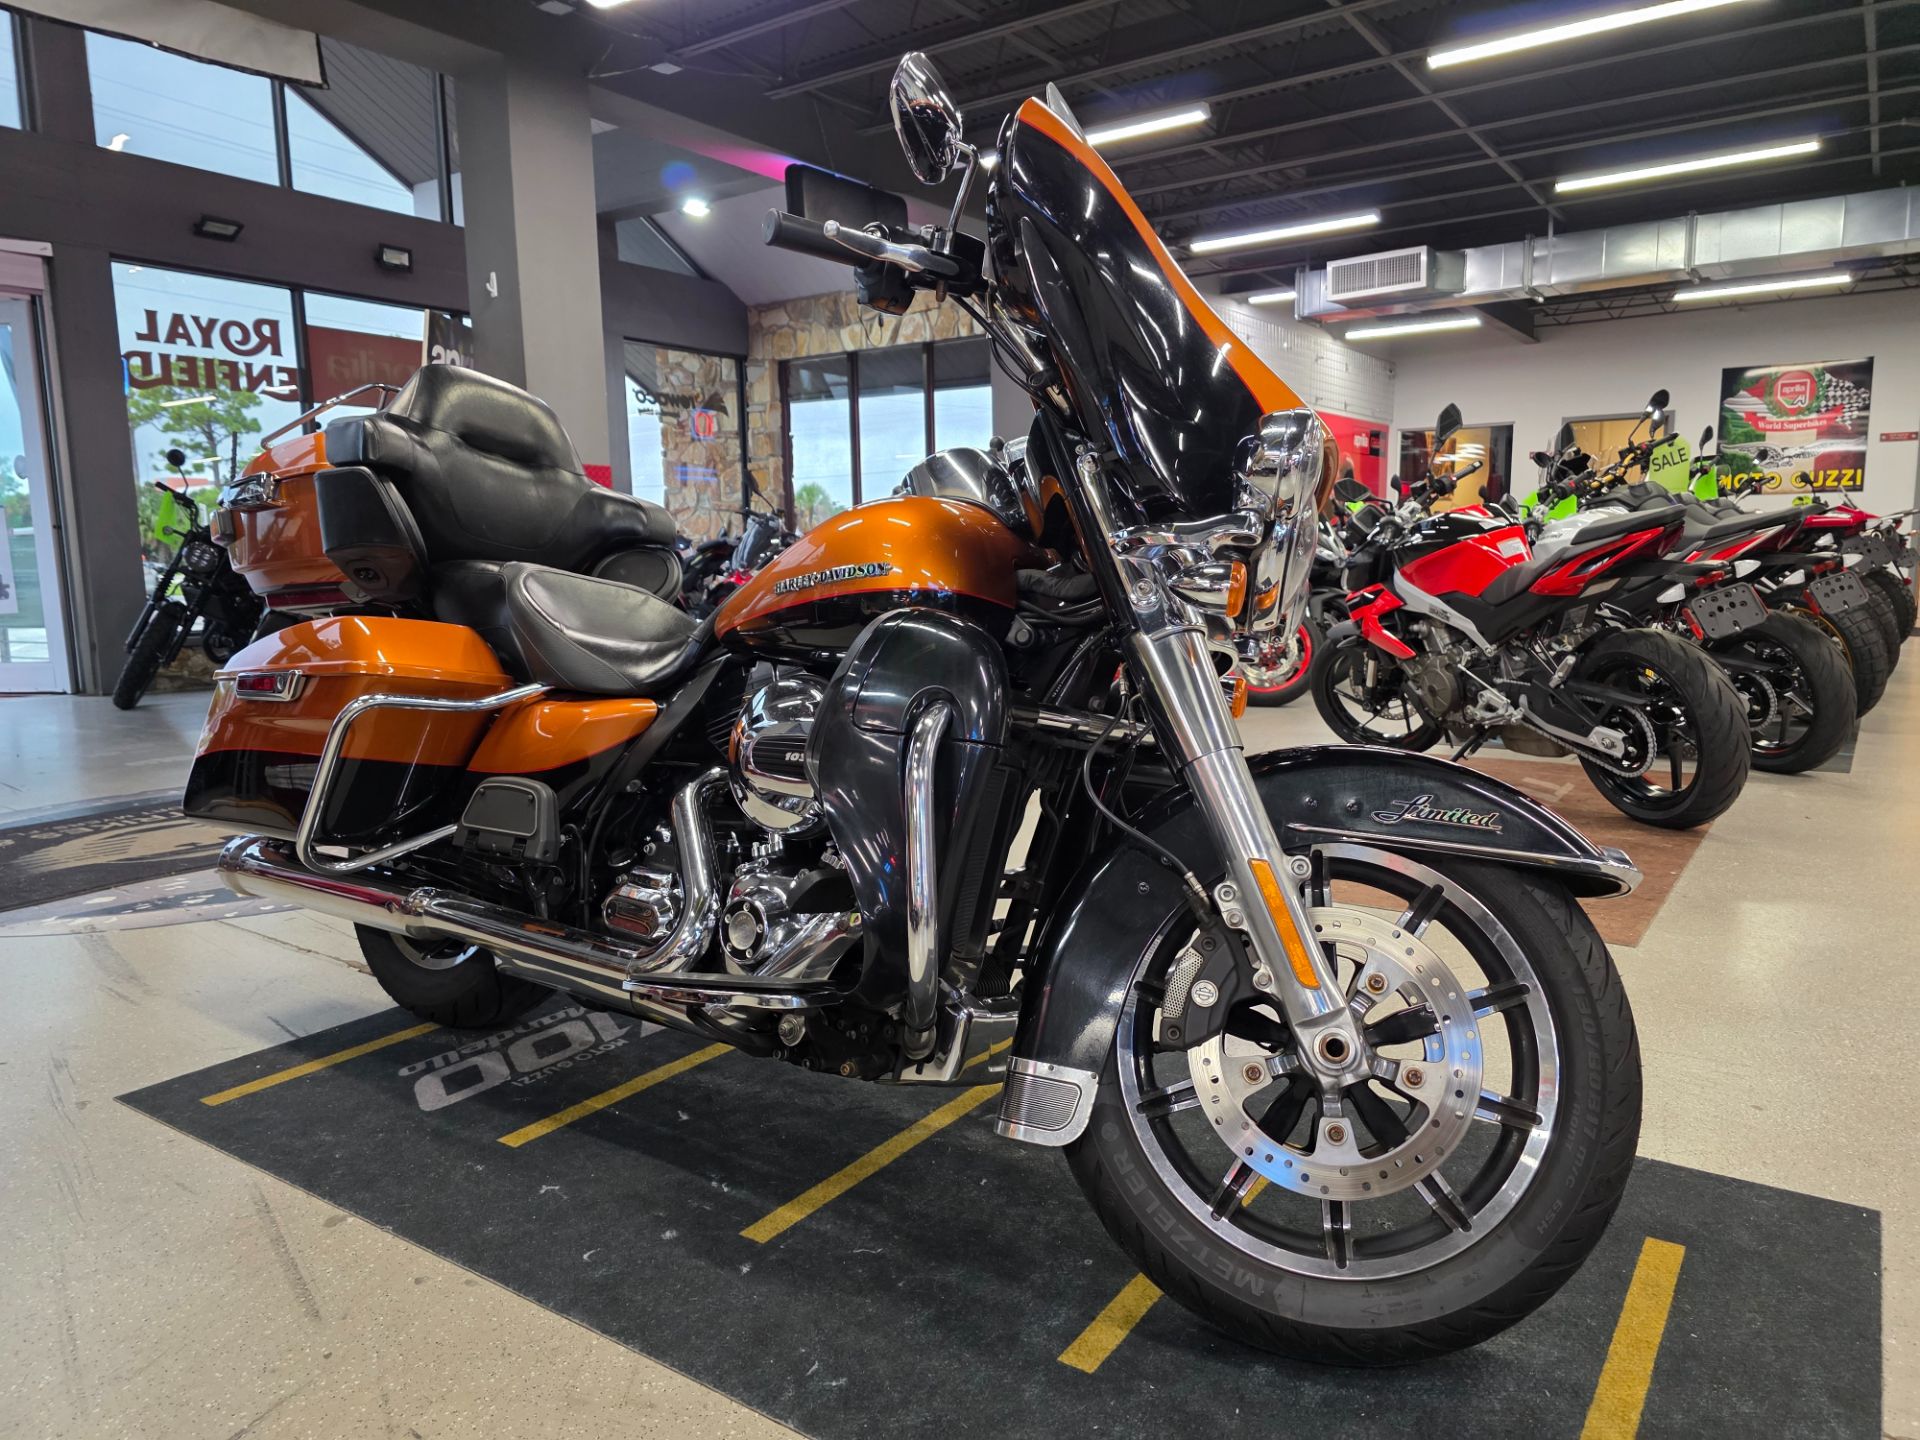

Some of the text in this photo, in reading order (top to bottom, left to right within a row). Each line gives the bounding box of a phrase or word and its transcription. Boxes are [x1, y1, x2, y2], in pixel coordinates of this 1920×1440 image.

[1757, 418, 1828, 431] World Superbikes
[1651, 447, 1689, 472] SALE
[1791, 468, 1862, 489] GUZZI
[1371, 795, 1503, 830] Limited
[413, 1011, 668, 1112] 100
[510, 1038, 630, 1087] MOTO GUZZI
[1113, 1148, 1266, 1298] METZELER
